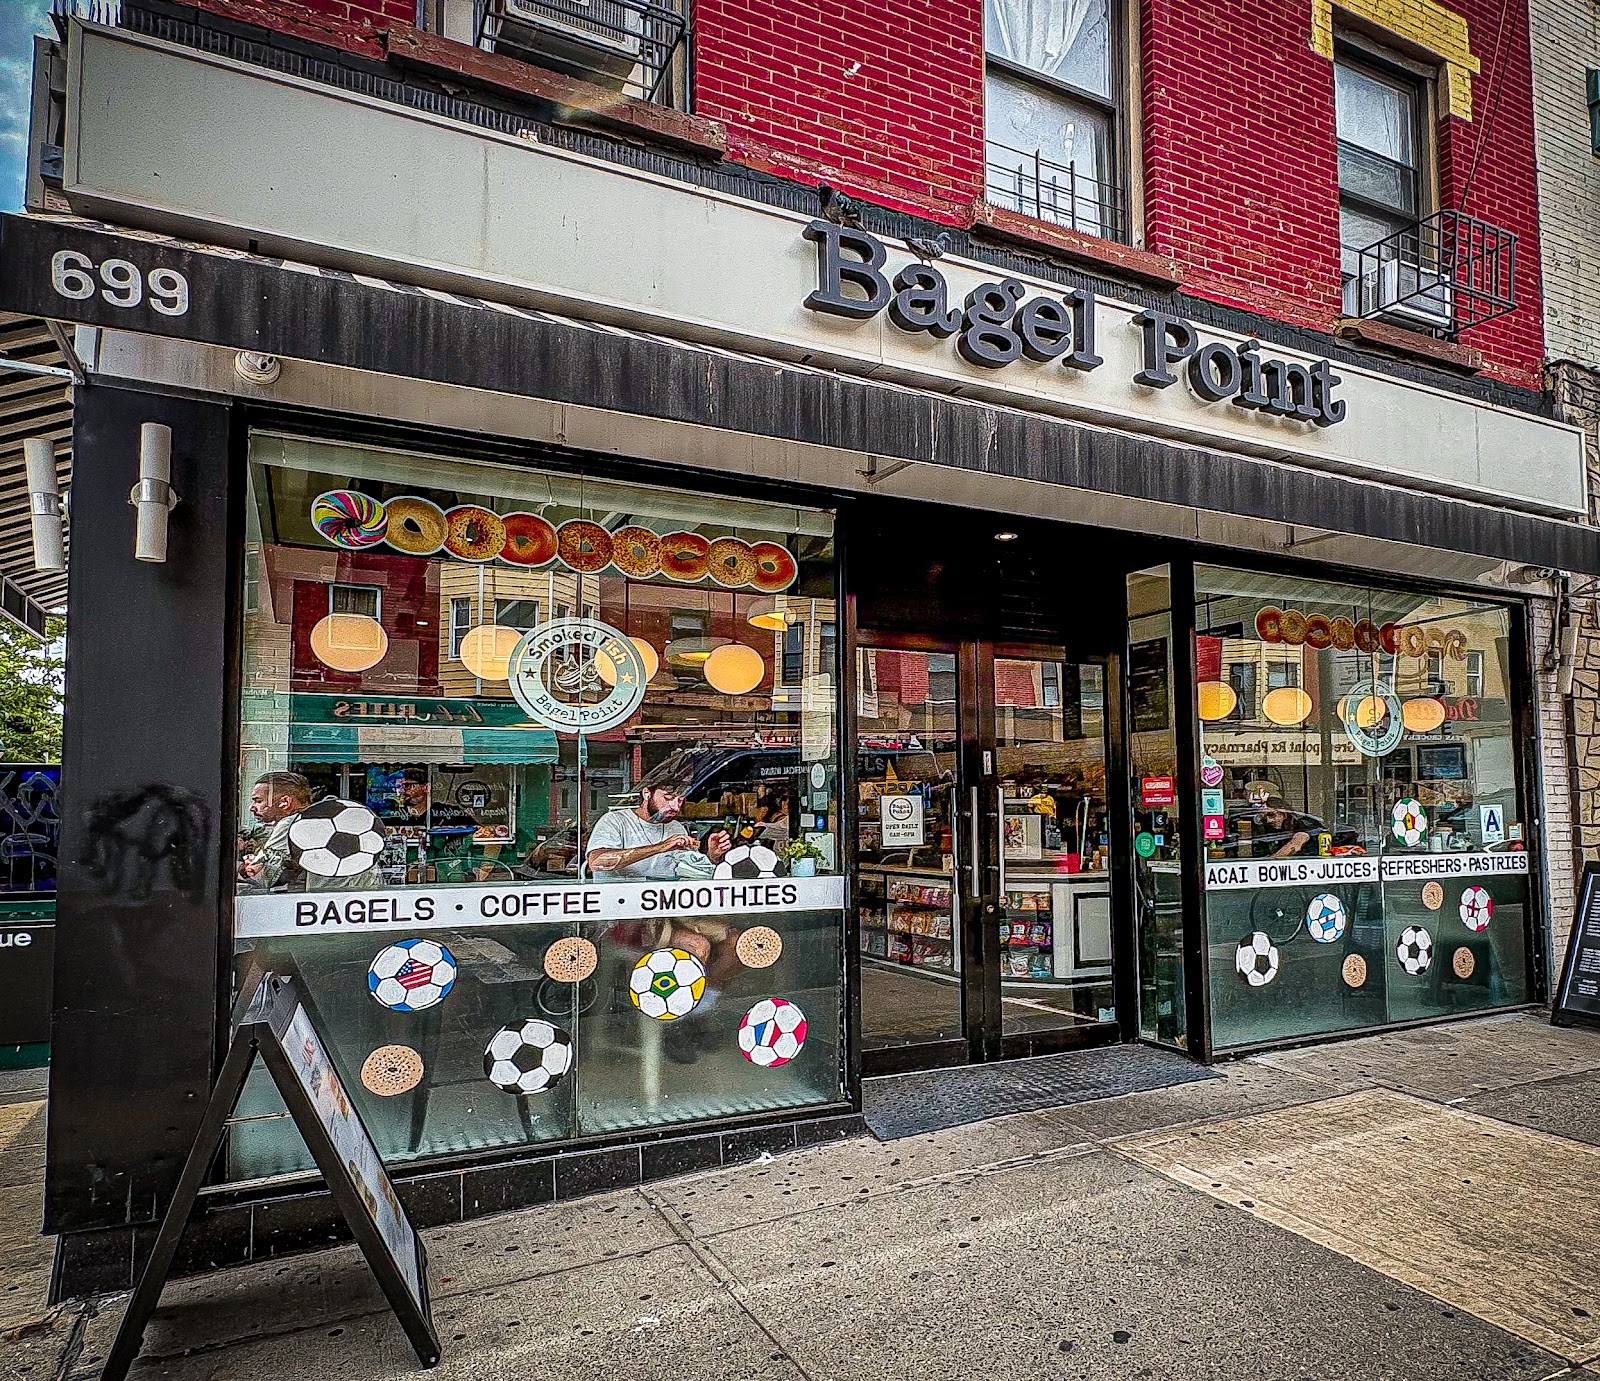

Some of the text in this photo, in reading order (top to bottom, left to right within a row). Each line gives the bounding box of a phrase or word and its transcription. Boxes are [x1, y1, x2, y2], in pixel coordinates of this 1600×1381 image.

[51, 250, 189, 316] 699
[802, 220, 1347, 429] Bagel Point
[529, 628, 627, 665] Smoked Fish
[535, 694, 623, 721] Bagel Point
[1485, 810, 1500, 831] A
[1207, 855, 1527, 885] ACAI BOWLS JUICES REFRESHERS PASTRIES
[295, 884, 798, 927] BAGELS COFFEE SMOOTHIES
